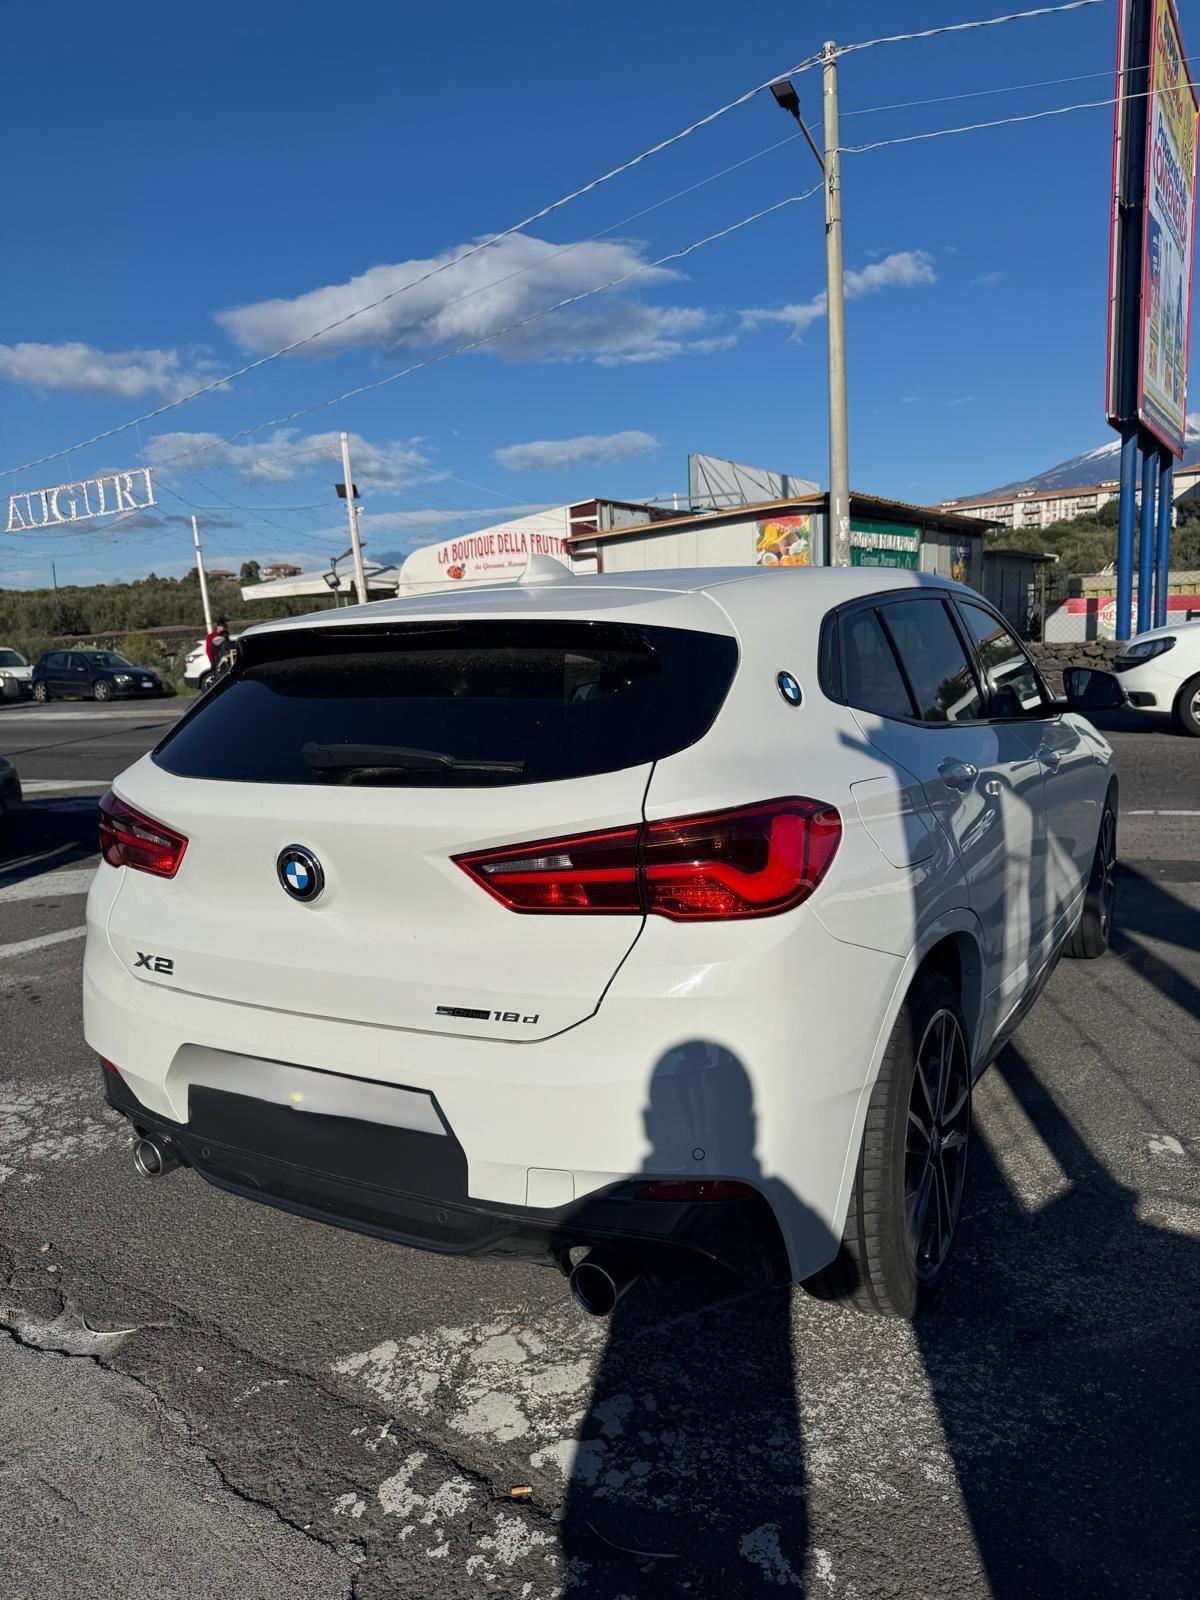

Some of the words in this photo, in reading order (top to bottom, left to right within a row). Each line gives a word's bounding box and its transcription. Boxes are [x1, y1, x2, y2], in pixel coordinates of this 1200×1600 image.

[5, 467, 157, 532] AUGURI
[437, 547, 449, 564] LA
[451, 535, 495, 562] BOUTIQUE
[497, 533, 528, 553] DELLA
[530, 533, 567, 556] FRUTTA
[134, 951, 174, 976] X2
